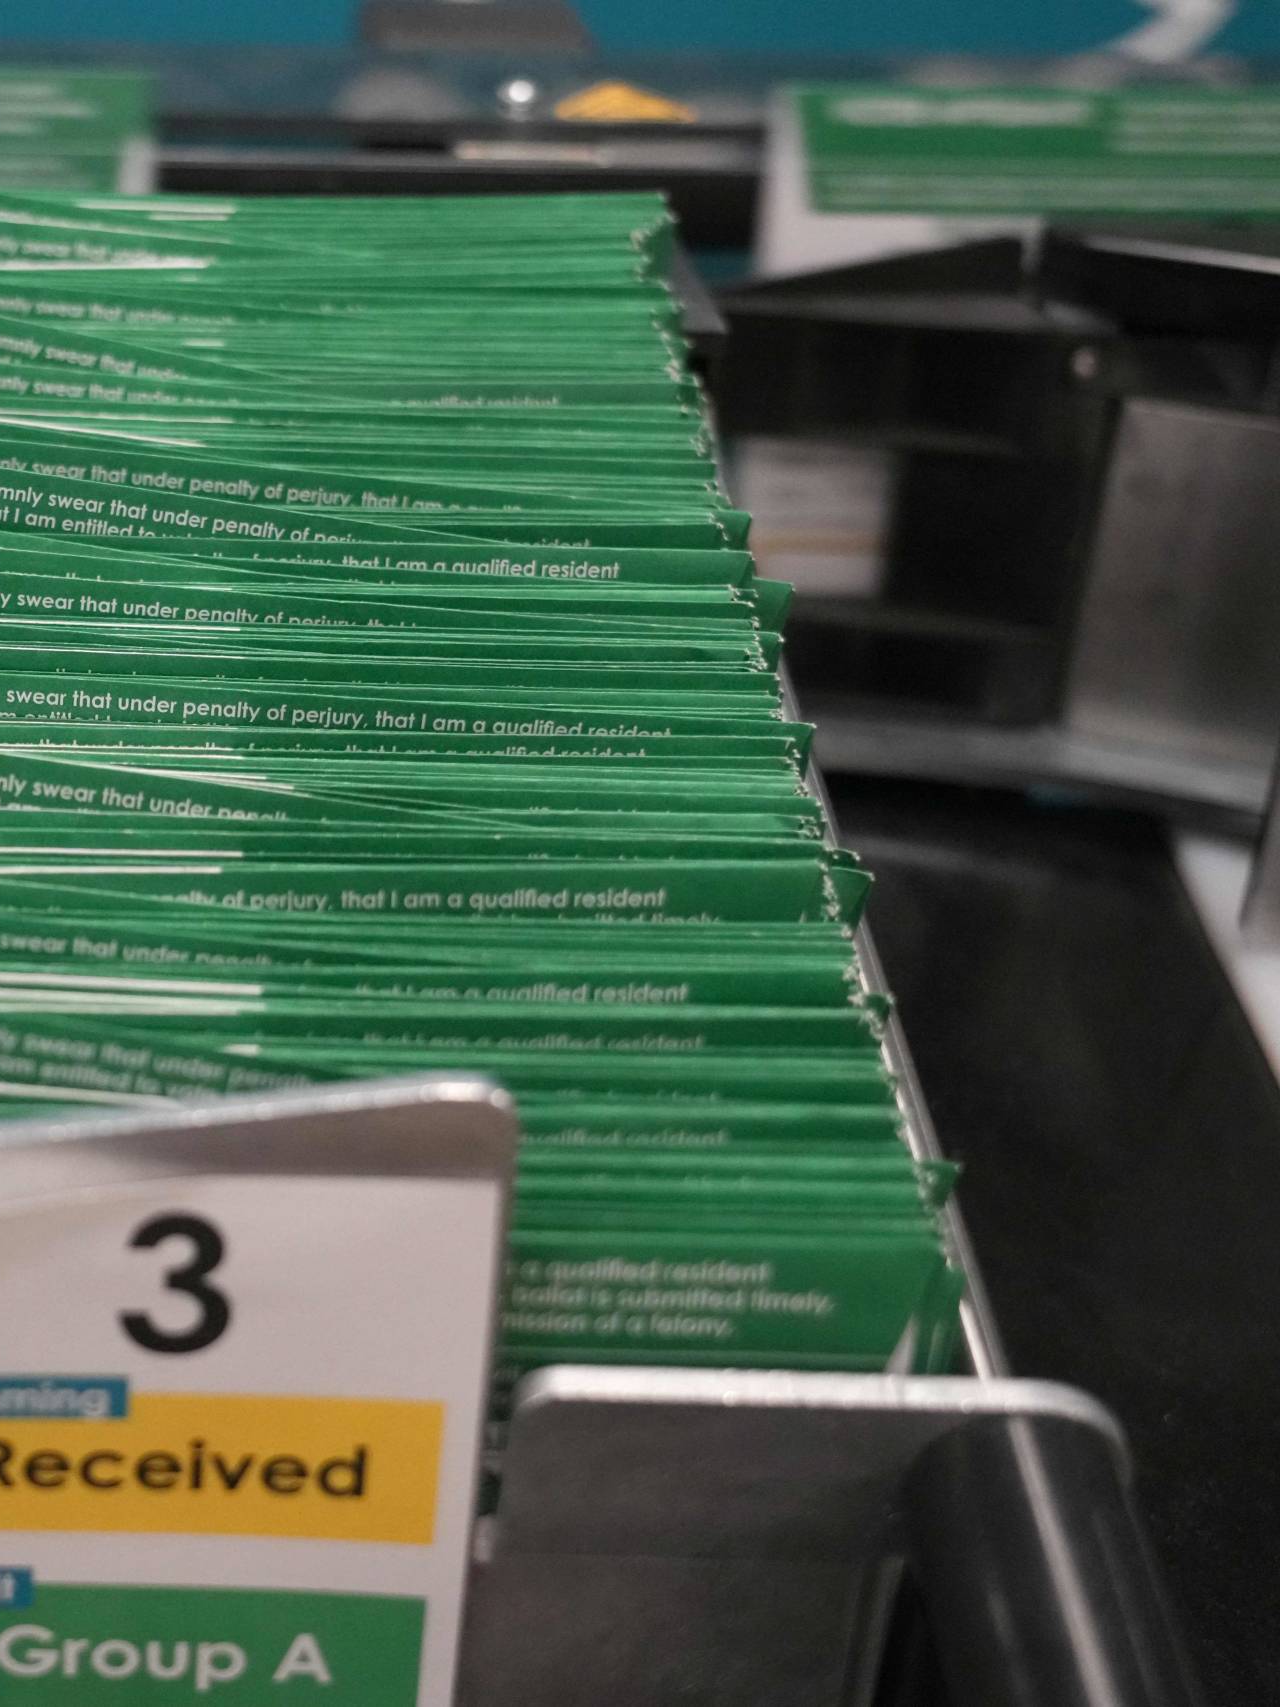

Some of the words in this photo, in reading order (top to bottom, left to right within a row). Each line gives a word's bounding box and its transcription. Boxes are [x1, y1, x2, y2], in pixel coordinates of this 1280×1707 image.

[91, 464, 128, 484] that
[131, 472, 185, 490] under
[189, 477, 260, 501] penalty
[264, 483, 285, 499] of
[13, 507, 20, 523] I
[25, 513, 56, 529] am
[61, 519, 133, 537] entitled
[48, 493, 106, 513] swear
[109, 499, 148, 520] that
[152, 509, 208, 528] under
[212, 518, 286, 541] penalty
[290, 527, 311, 542] of
[452, 558, 537, 577] qualified
[541, 560, 621, 579] resident
[16, 592, 76, 610] swear
[79, 594, 118, 614] that
[123, 601, 180, 618] under
[6, 689, 67, 706] swear
[72, 689, 113, 709] that
[118, 696, 178, 714] under
[183, 701, 261, 723] penalty
[267, 704, 288, 721] of
[292, 707, 368, 730] perjury,
[375, 710, 417, 729] that
[421, 713, 427, 730] I
[432, 717, 466, 732] am
[472, 719, 487, 733] a
[492, 719, 583, 735] qualified
[32, 780, 96, 803] swear
[102, 787, 145, 810] that
[149, 798, 213, 817] under
[341, 888, 386, 910] that
[391, 889, 397, 909] I
[403, 892, 441, 910] am
[447, 893, 464, 910] a
[469, 888, 569, 912] qualified
[573, 887, 668, 909] resident
[593, 982, 690, 1003] resident
[118, 1208, 233, 1355] 3
[273, 1631, 333, 1684] A
